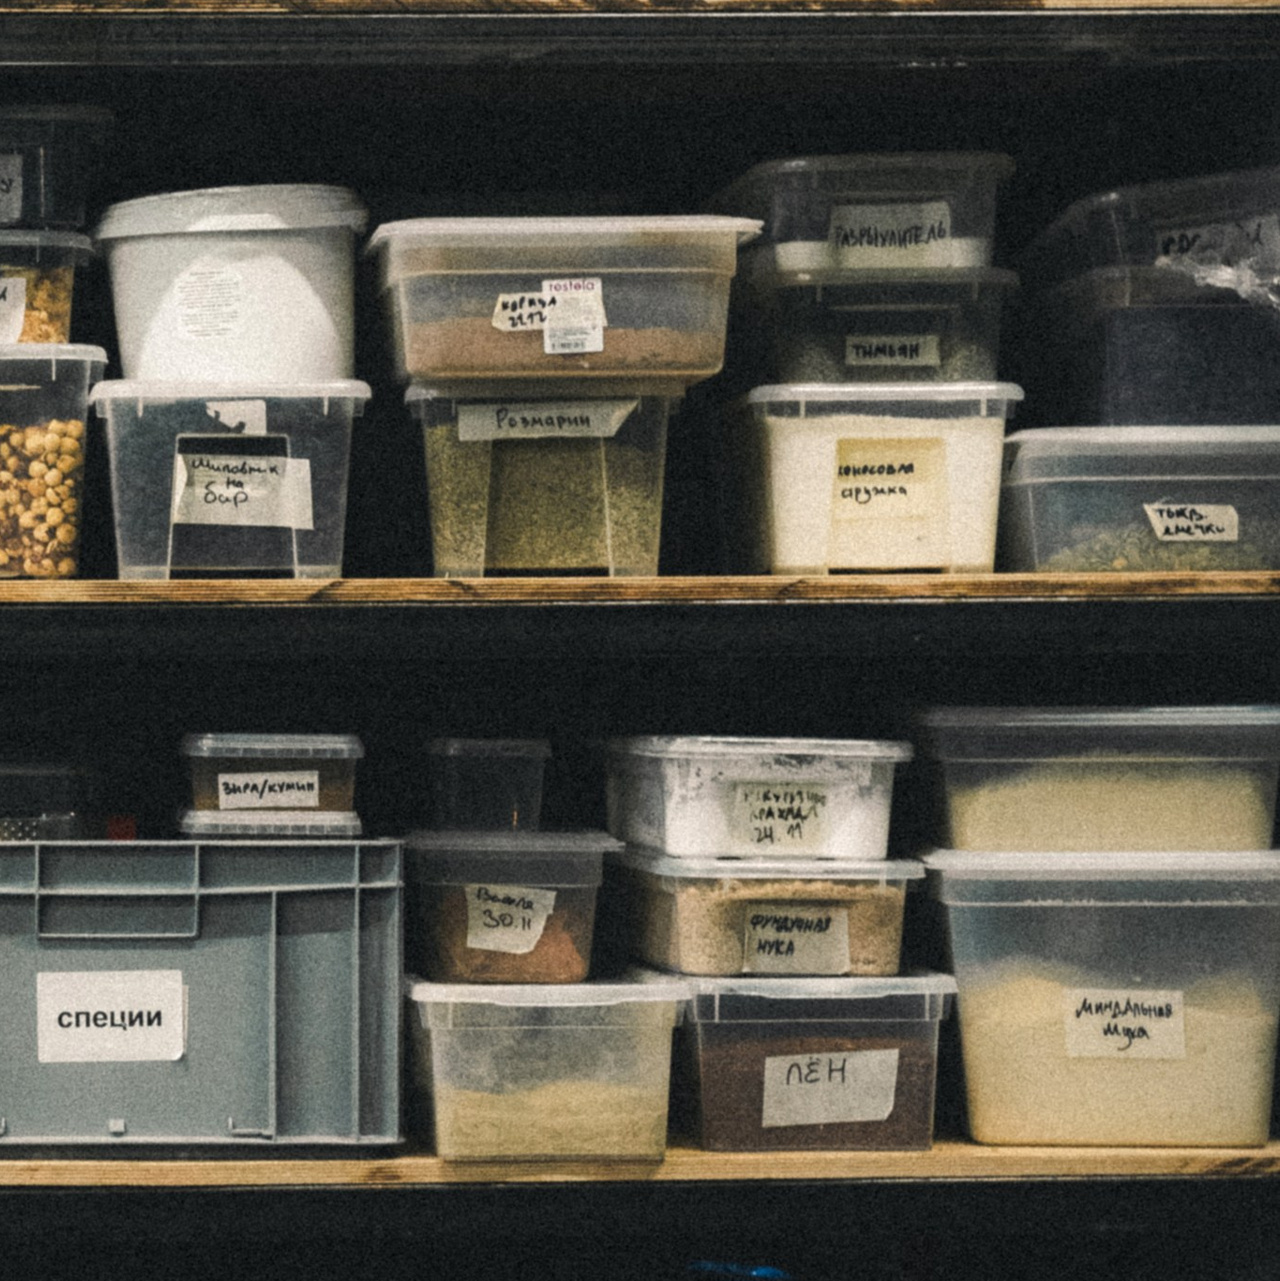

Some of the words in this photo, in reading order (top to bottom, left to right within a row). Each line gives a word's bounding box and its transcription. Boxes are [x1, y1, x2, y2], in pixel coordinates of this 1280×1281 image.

[495, 407, 591, 430] Розмарин
[203, 480, 249, 508] бар
[225, 476, 245, 490] на
[57, 1009, 163, 1031] специи
[786, 1055, 847, 1086] ЛЁН
